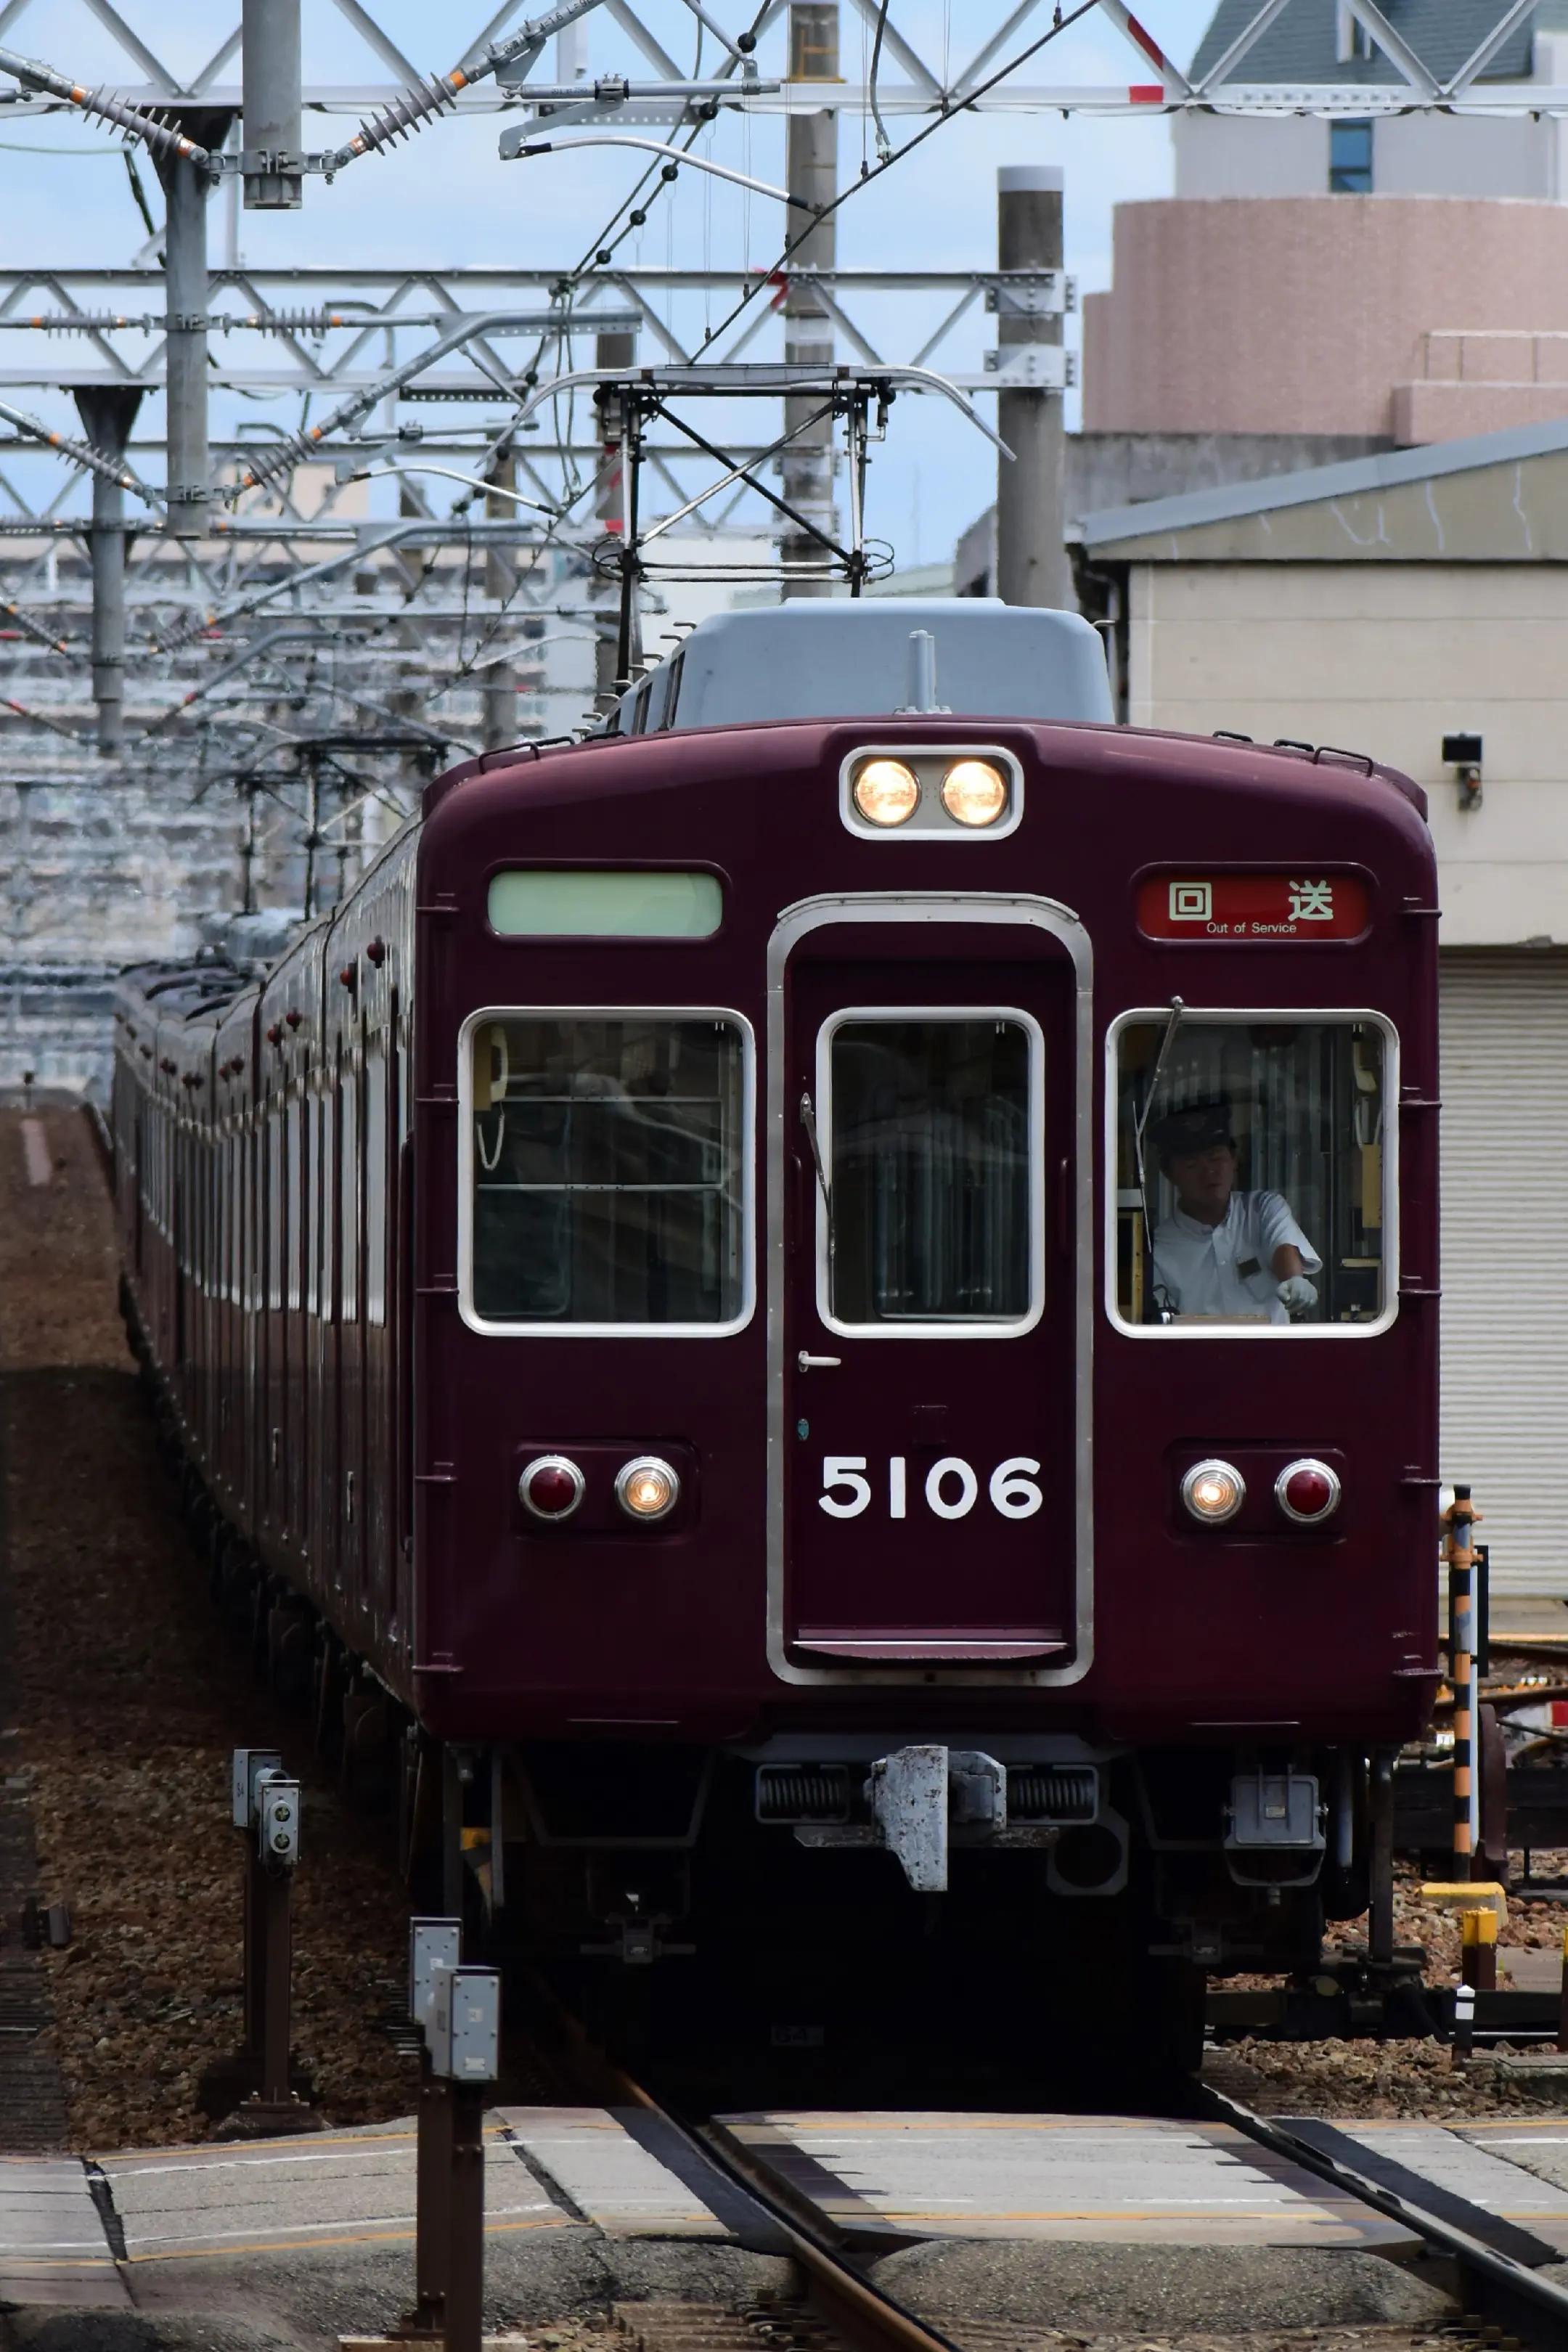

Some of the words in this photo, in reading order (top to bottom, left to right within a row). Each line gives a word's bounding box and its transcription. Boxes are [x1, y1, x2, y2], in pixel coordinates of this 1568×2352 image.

[1169, 880, 1334, 922] 回送
[1206, 922, 1228, 934] Out
[1234, 922, 1246, 934] of
[1251, 922, 1297, 934] Service
[818, 1456, 1043, 1519] 5106
